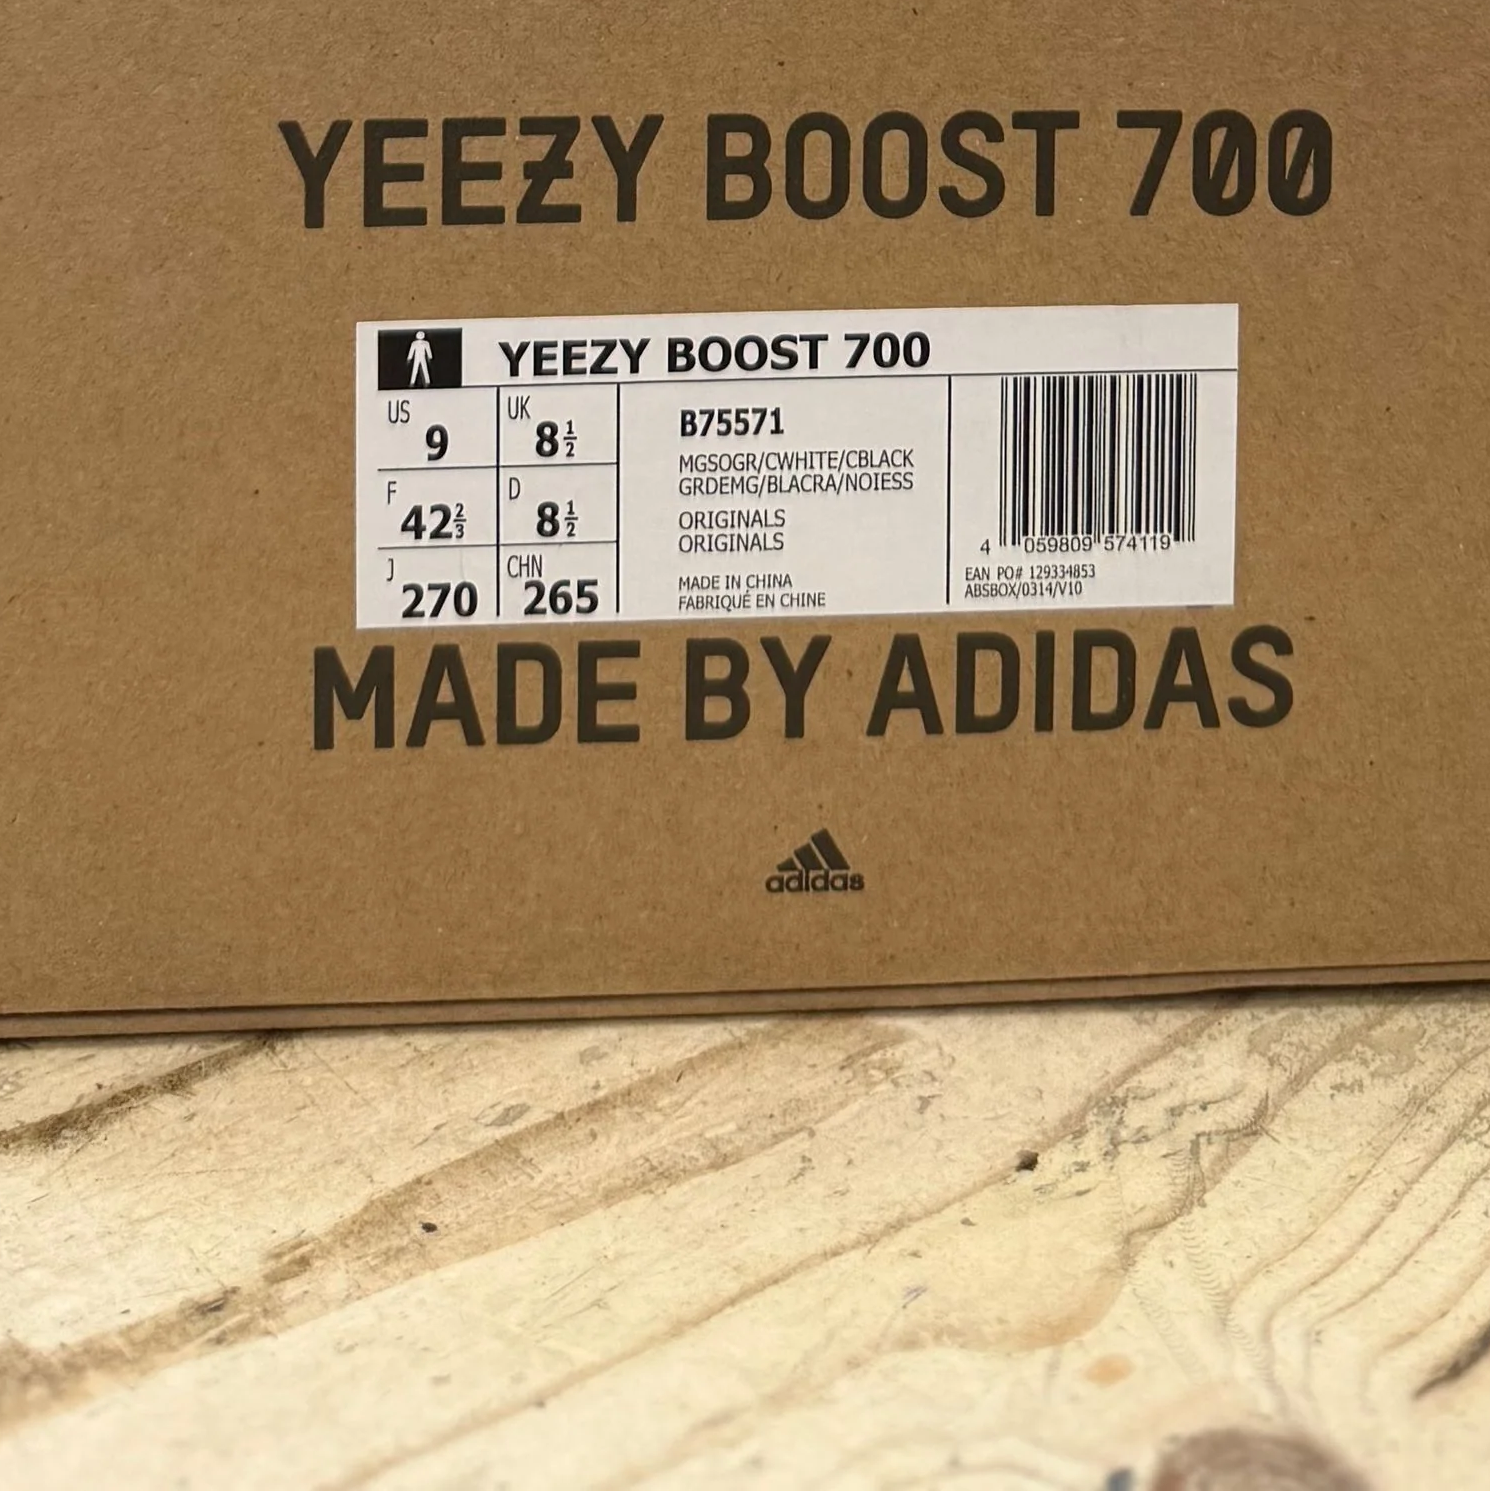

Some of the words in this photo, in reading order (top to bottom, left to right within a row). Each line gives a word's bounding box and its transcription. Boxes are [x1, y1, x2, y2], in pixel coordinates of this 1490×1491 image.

[278, 114, 665, 228] YEEZY
[707, 110, 1080, 219] BOOST
[1116, 109, 1332, 217] 700
[498, 337, 651, 377] YEEZY
[667, 334, 829, 374] BOOST
[843, 331, 931, 369] 700
[387, 399, 411, 423] US
[507, 395, 531, 419] UK
[679, 407, 784, 437] B75571
[425, 424, 449, 461] 9
[679, 449, 914, 474] MGSOGR/CWHITE/CBLACK
[387, 480, 397, 505] F
[508, 477, 521, 500] D
[679, 472, 914, 497] GRDEMG/BLACRA/NOIESS
[679, 509, 786, 530] ORIGINALS
[679, 532, 784, 553] ORIGINALS
[980, 539, 991, 555] 4
[1024, 536, 1093, 553] 059809
[1104, 535, 1171, 551] 574119
[386, 558, 394, 581] J
[507, 554, 542, 578] CHN
[965, 567, 990, 581] EAN
[997, 565, 1023, 580] PO#
[1030, 564, 1096, 579] 129334853
[679, 576, 720, 591] MADE
[725, 575, 740, 590] IN
[746, 574, 792, 589] CHINA
[964, 581, 1083, 599] ABSBOX/0314/V10
[402, 581, 478, 618] 270
[524, 579, 598, 615] 265
[679, 589, 751, 612] FABRIQUÉ
[756, 593, 775, 608] EN
[780, 592, 826, 607] CHINE
[314, 640, 641, 750] MADE
[686, 634, 832, 740] BY
[866, 625, 1294, 737] ADIDAS
[765, 869, 865, 893] adidas
